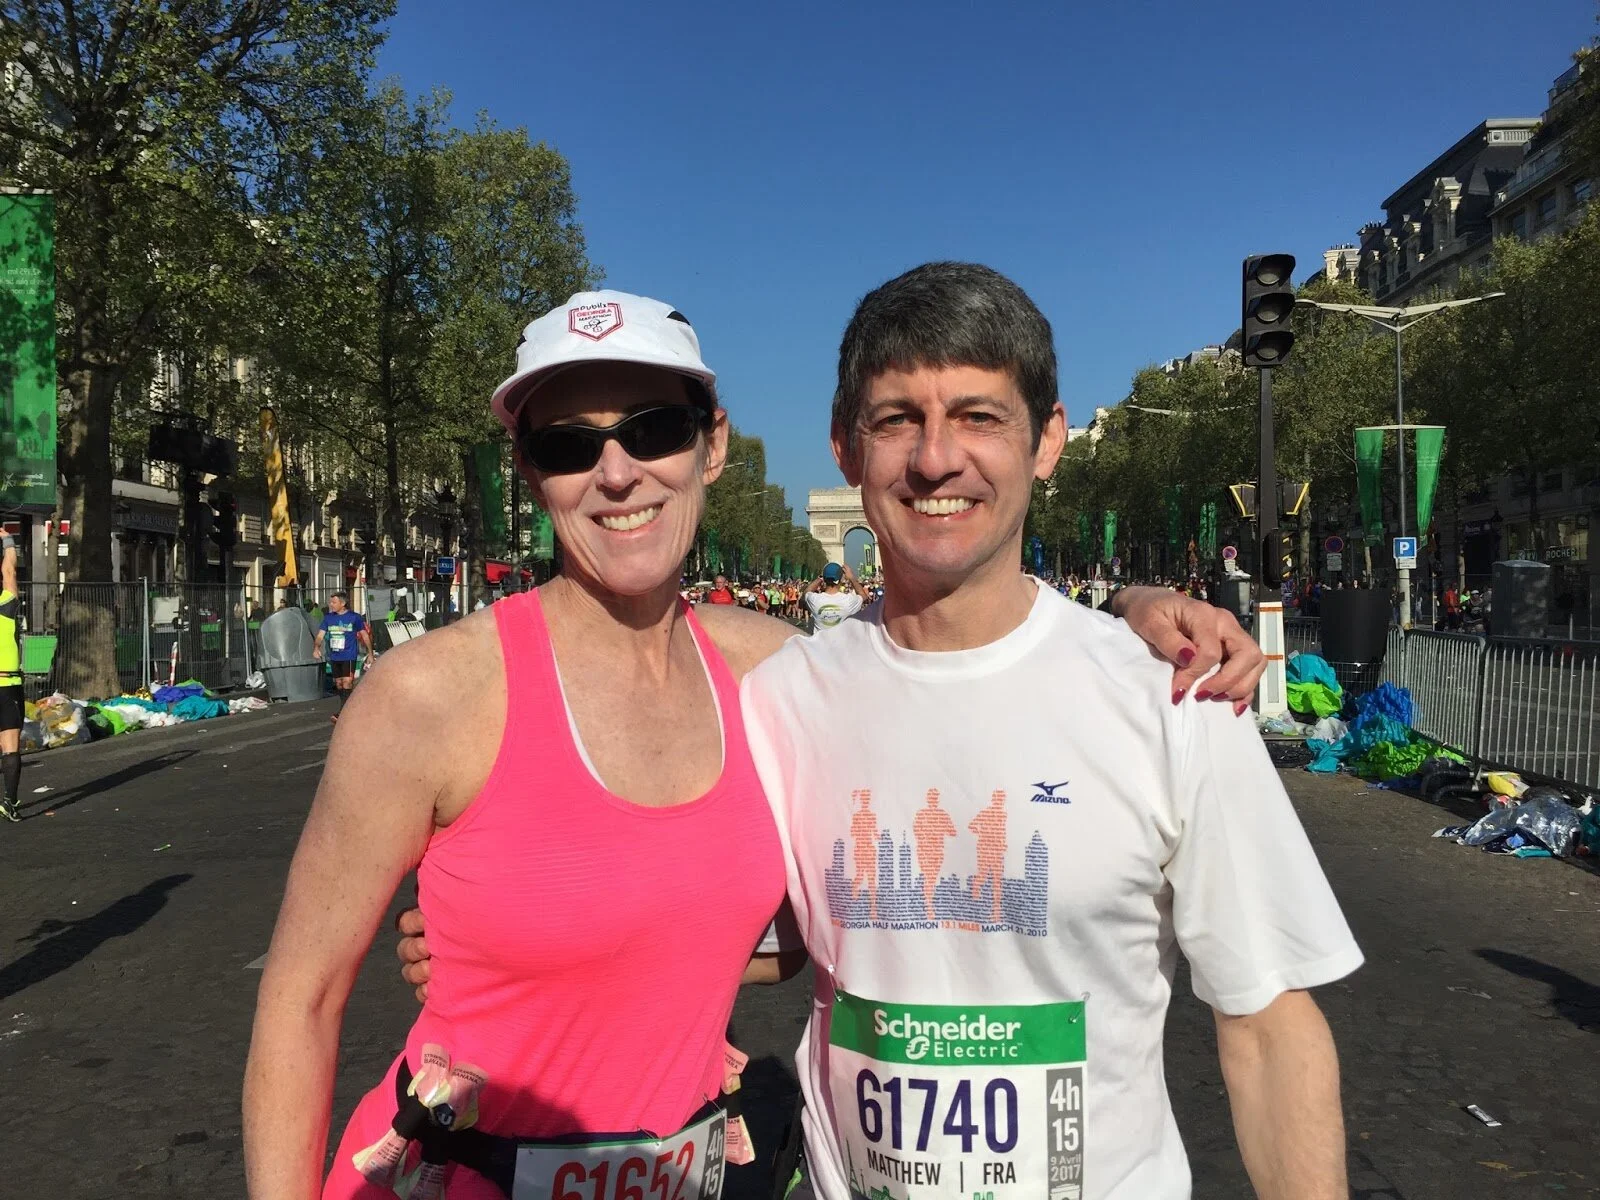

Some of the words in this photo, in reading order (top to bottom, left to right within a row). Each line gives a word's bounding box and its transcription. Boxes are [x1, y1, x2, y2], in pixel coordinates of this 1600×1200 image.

[1399, 541, 1410, 554] P
[872, 921, 889, 930] HALF
[890, 921, 939, 930] MARATHON
[958, 922, 980, 932] MILES
[981, 923, 1015, 933] MARCH
[874, 1009, 1022, 1040] Schneider
[933, 1042, 1019, 1058] Electric
[856, 1068, 1019, 1154] 61740
[1049, 1078, 1080, 1111] 4h
[706, 1126, 724, 1162] 4h
[1052, 1117, 1079, 1151] 15
[552, 1140, 695, 1200] 61652
[866, 1147, 941, 1185] MATTHEW
[983, 1161, 1016, 1185] FRA
[1050, 1156, 1058, 1166] 9
[1059, 1153, 1081, 1166] Avril
[1050, 1163, 1080, 1181] 2017
[703, 1165, 720, 1198] 15
